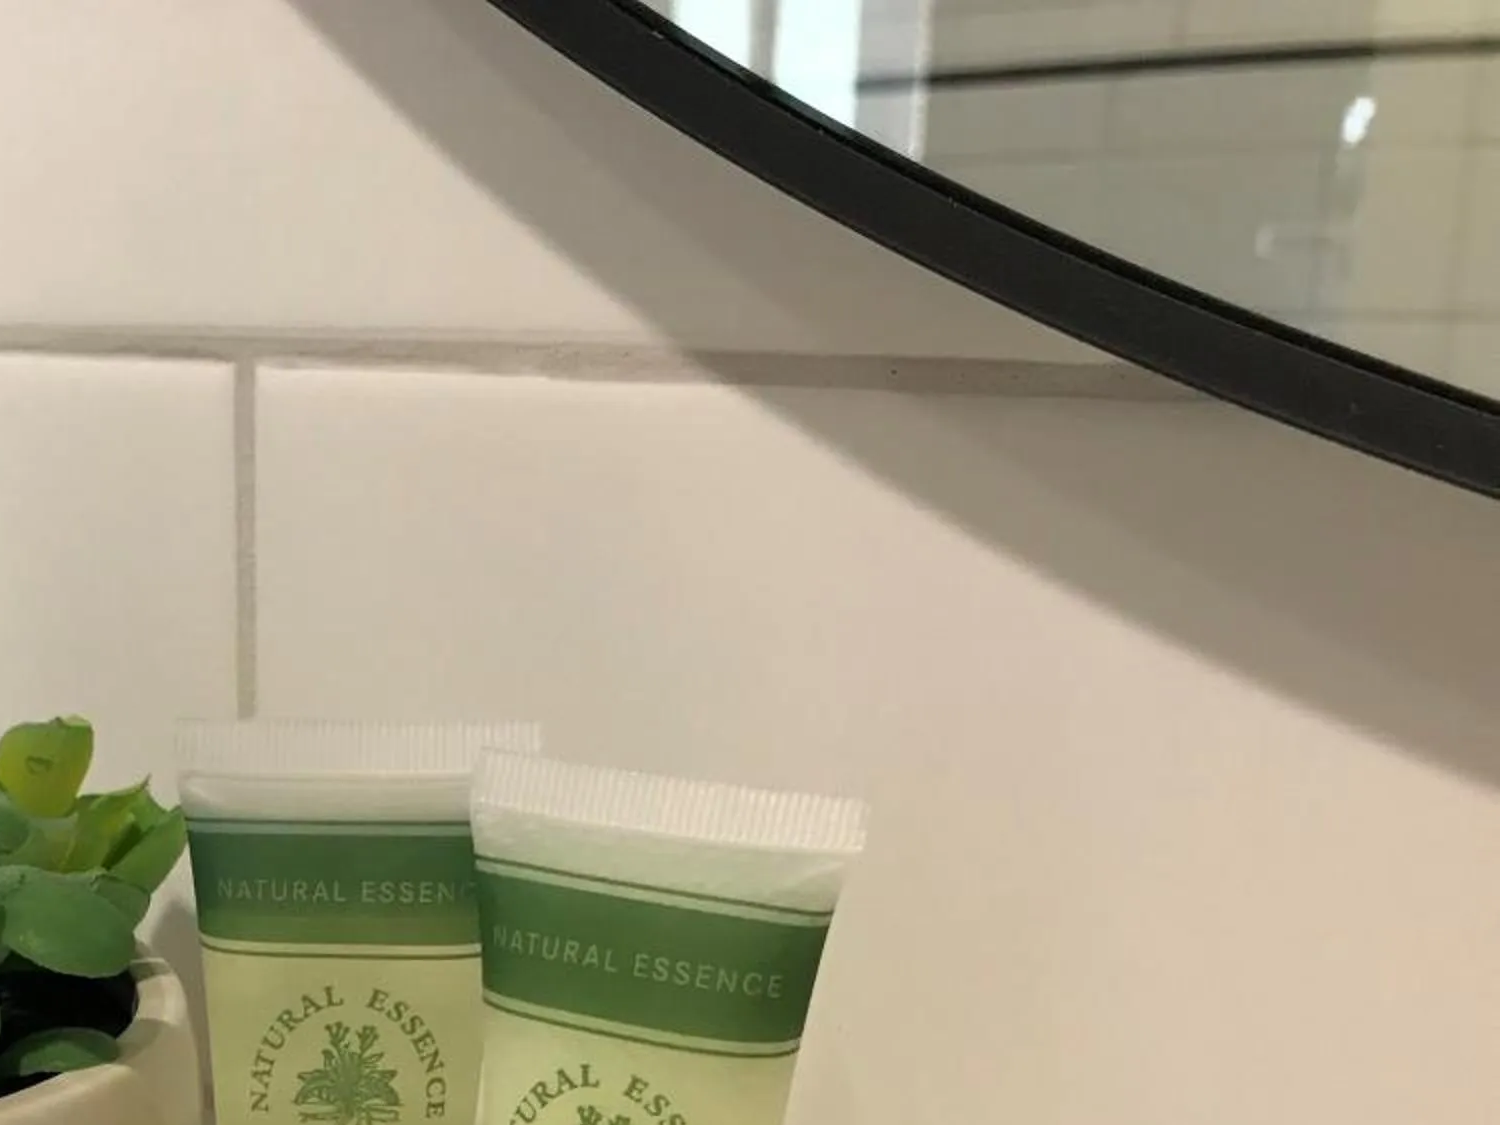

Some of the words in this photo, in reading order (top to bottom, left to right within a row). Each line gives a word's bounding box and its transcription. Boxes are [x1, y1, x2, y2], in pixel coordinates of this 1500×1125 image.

[216, 878, 347, 902] NATURAL
[360, 879, 477, 903] ESSENC
[493, 925, 618, 973] NATURAL
[633, 953, 784, 999] ESSENCE
[250, 985, 344, 1114] NATURAL
[364, 987, 446, 1119] ESSENCE
